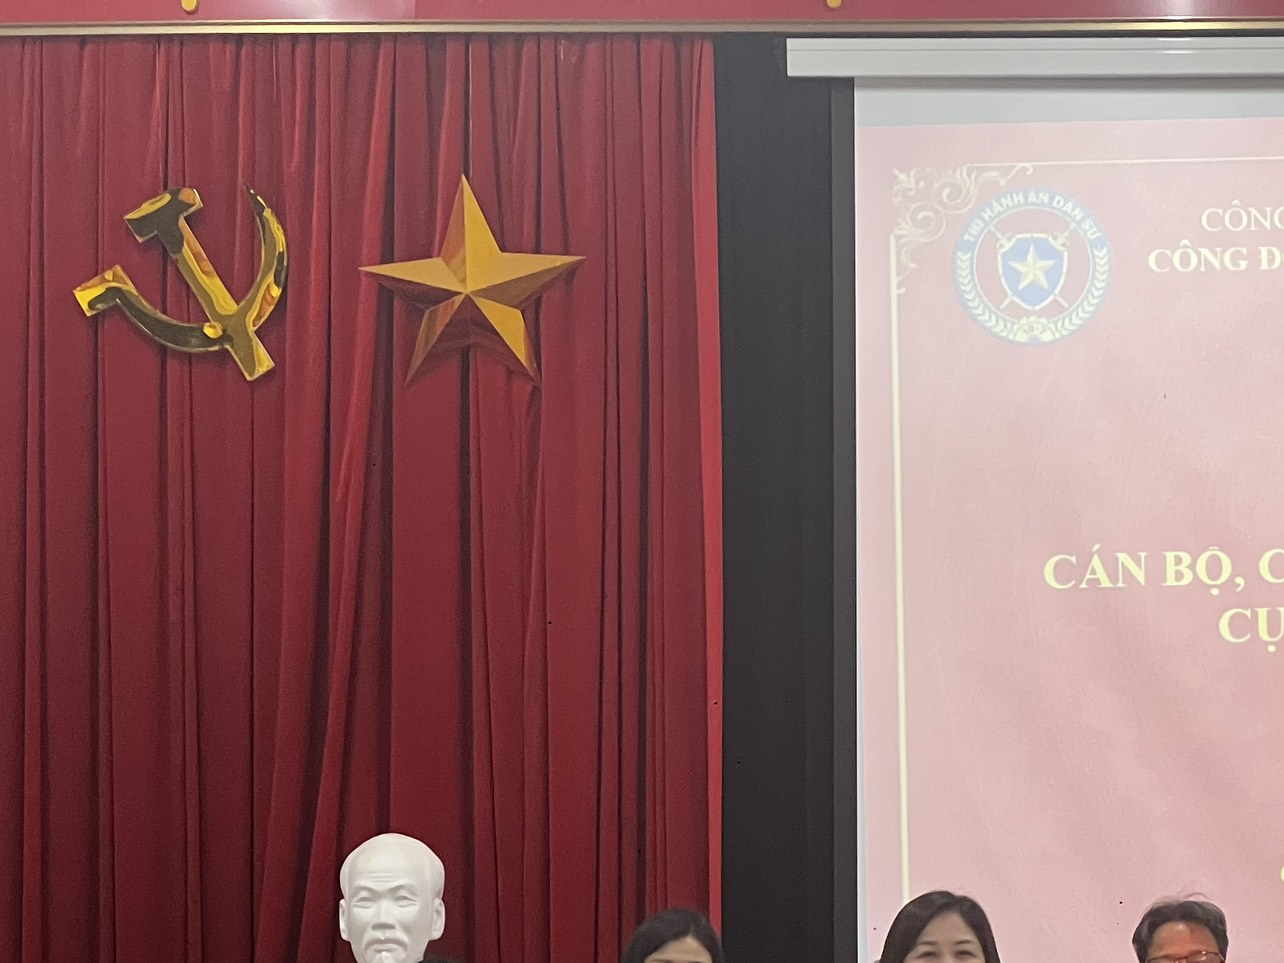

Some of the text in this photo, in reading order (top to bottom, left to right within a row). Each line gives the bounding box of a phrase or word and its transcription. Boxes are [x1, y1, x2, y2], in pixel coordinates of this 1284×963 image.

[1148, 239, 1248, 272] CÔNG
[1043, 544, 1147, 590] CÁN
[1163, 547, 1247, 596] BỘ,
